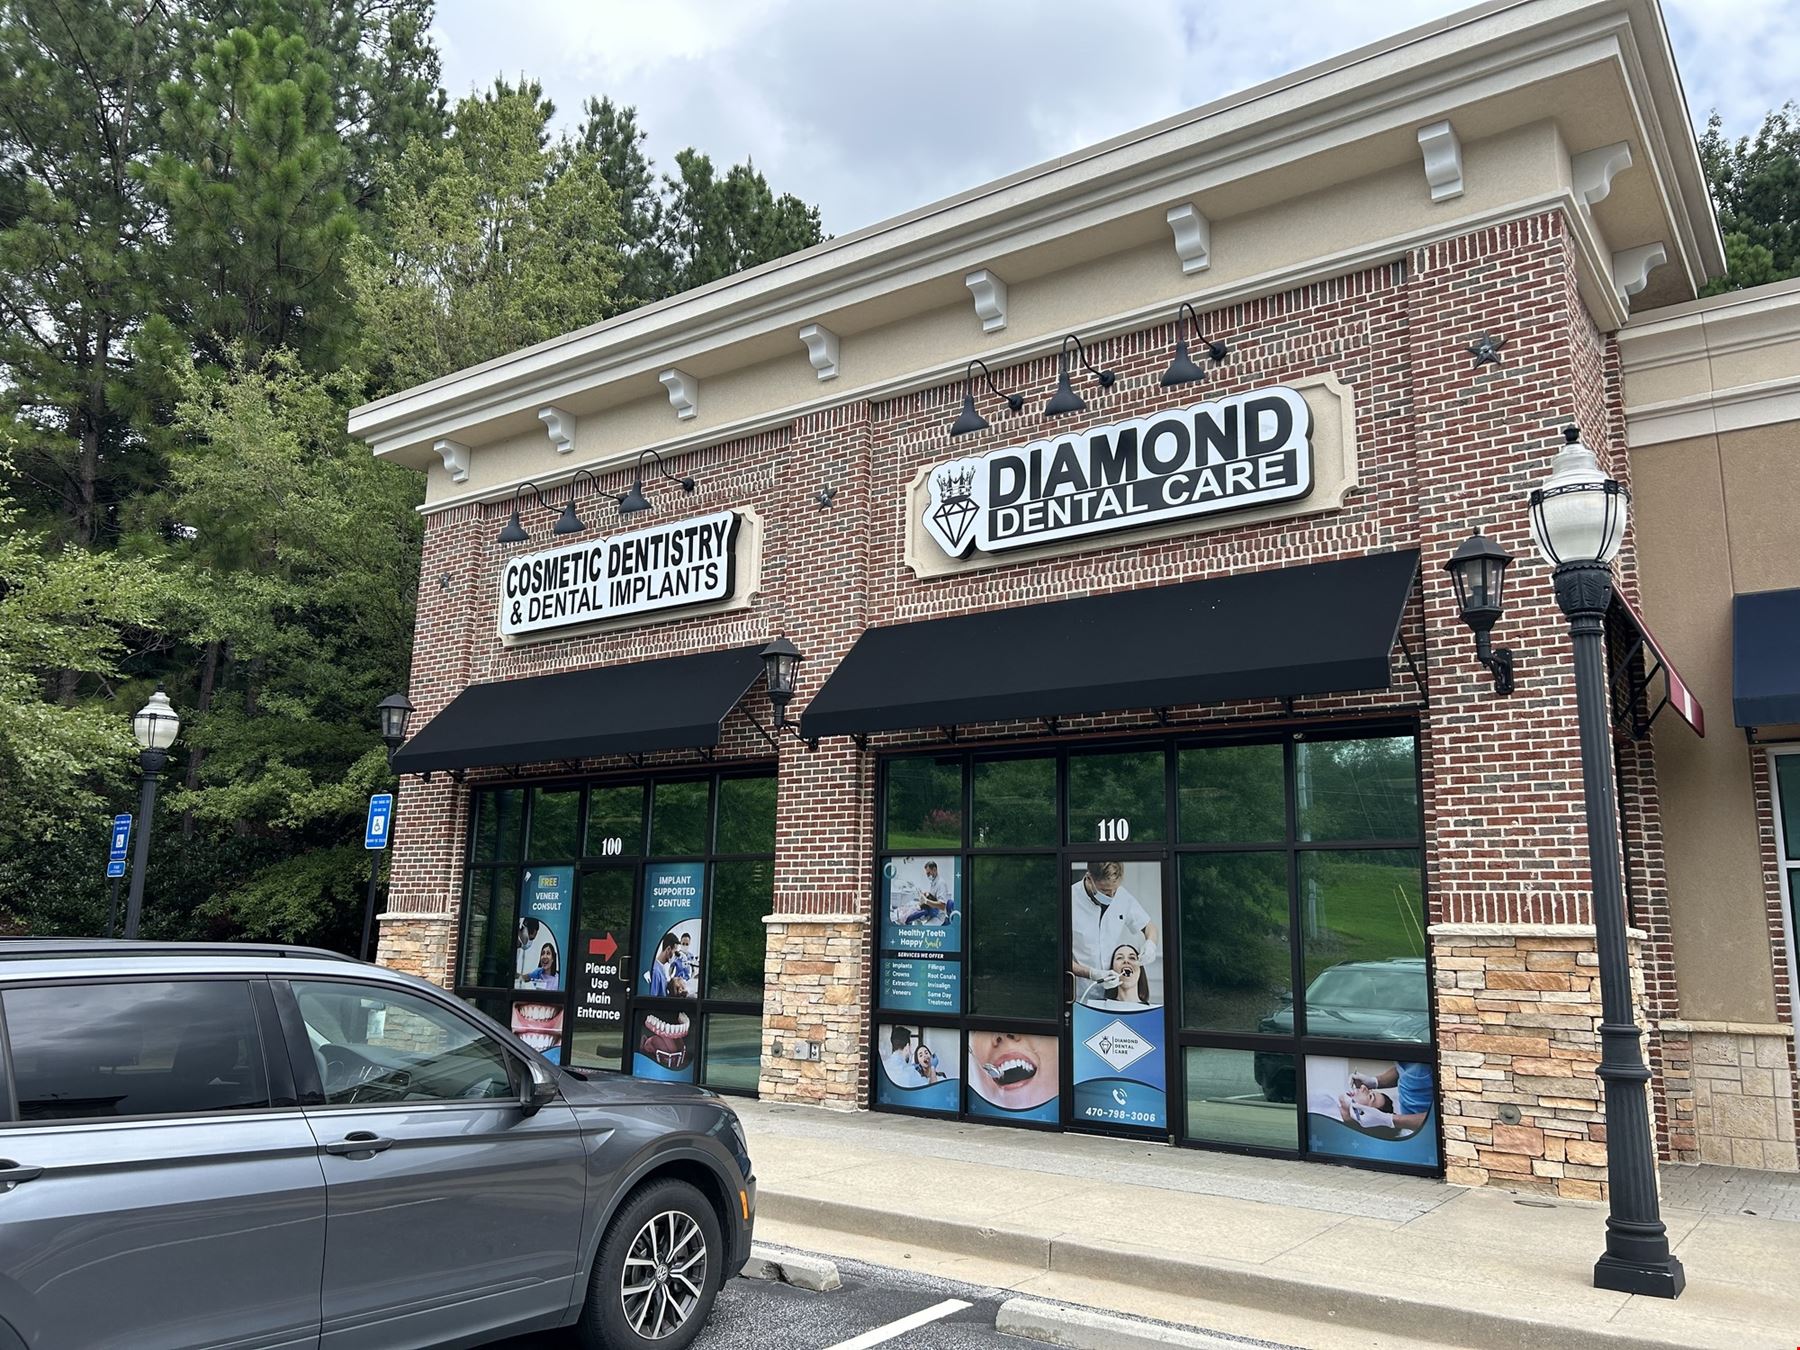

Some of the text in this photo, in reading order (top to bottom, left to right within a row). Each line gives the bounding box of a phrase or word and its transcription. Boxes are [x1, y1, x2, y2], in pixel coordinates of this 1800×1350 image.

[989, 396, 1293, 509] DIAMOND
[996, 453, 1286, 537] DENTAL CARE
[506, 519, 728, 598] COSMETIC DENTISTRY
[510, 562, 718, 625] & DENTAL IMPLANTS
[1097, 818, 1129, 842] 110
[601, 837, 622, 856] 100
[540, 877, 558, 887] FREE
[659, 876, 692, 885] IMPLANT
[535, 892, 560, 901] VENEER
[653, 887, 696, 896] SUPPORTED
[532, 902, 562, 911] CONSULT
[658, 898, 691, 907] DENTURE
[898, 929, 946, 938] Healthy Teeth
[900, 938, 924, 948] Happy
[585, 962, 617, 975] Please
[591, 977, 609, 989] Use
[928, 982, 950, 990] Invisalign
[587, 992, 611, 1005] Main
[577, 1007, 621, 1020] Entrance
[1085, 1107, 1156, 1122] 470-798-3006
